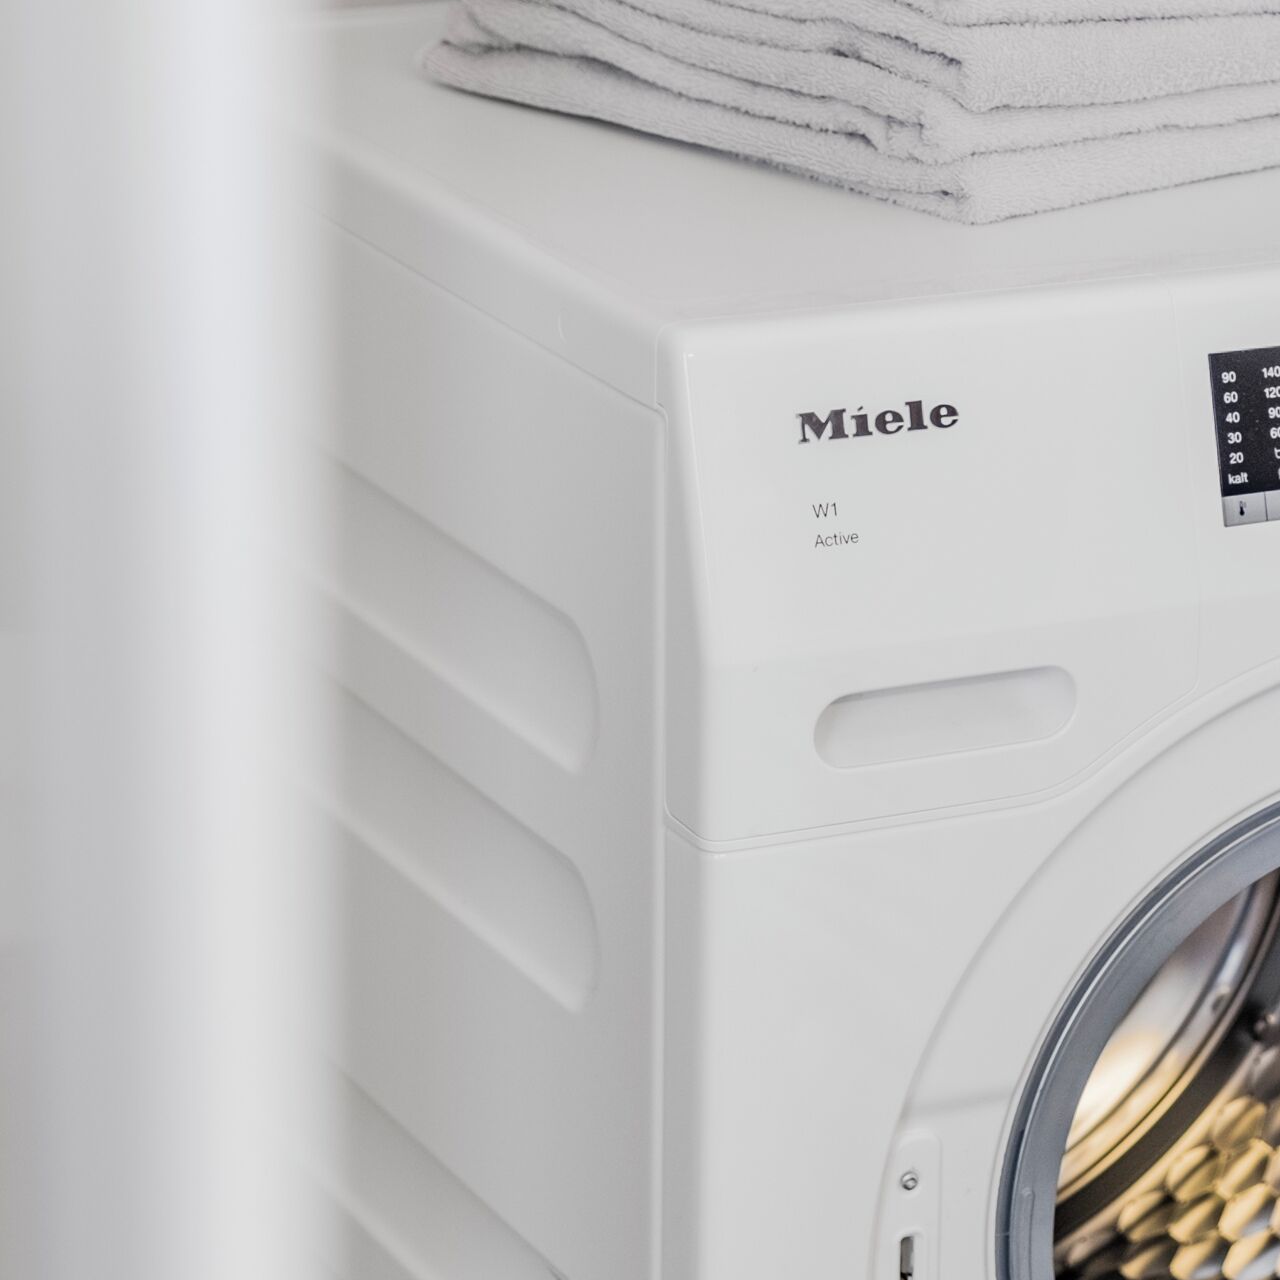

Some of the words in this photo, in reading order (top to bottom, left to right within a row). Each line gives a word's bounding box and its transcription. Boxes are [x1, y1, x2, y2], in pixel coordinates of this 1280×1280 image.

[1221, 371, 1236, 383] 90
[1223, 391, 1238, 404] 60
[796, 400, 959, 445] Miele
[1225, 411, 1240, 423] 40
[1227, 431, 1242, 444] 30
[1229, 451, 1244, 464] 20
[1227, 472, 1249, 484] kalt
[812, 502, 838, 519] W1
[814, 531, 860, 548] Active
